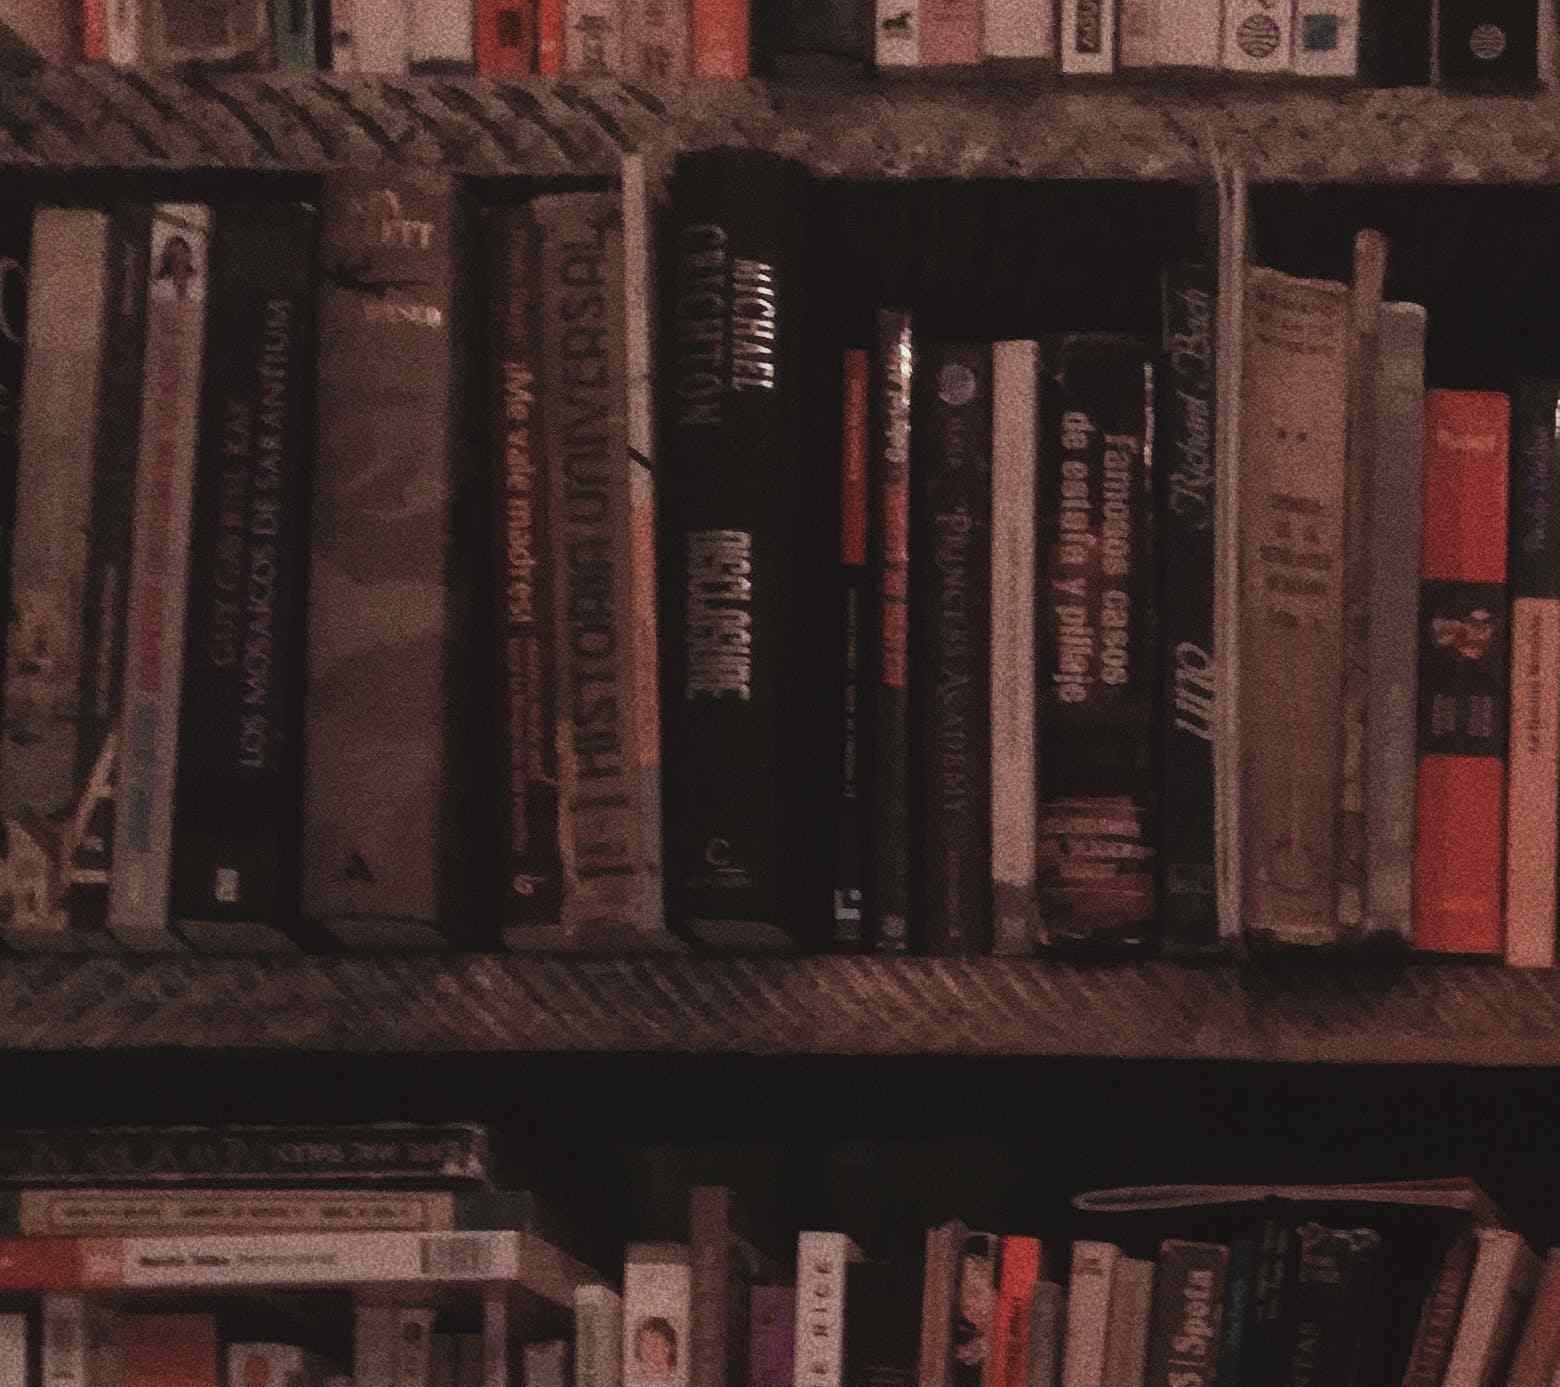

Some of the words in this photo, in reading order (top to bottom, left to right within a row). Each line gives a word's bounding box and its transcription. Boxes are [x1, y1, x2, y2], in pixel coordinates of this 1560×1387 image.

[671, 223, 730, 429] CRICHTON
[730, 261, 775, 391] MICHAEL
[557, 232, 613, 528] UNIVERSAL
[1060, 411, 1095, 449] de
[1058, 460, 1097, 566] estafa
[1100, 434, 1138, 574] Famosos
[1053, 576, 1089, 595] y
[1052, 604, 1095, 704] pillaje
[1100, 590, 1132, 685] casos
[237, 714, 268, 769] LOS
[811, 1258, 833, 1339] RICE
[1172, 1268, 1216, 1356] Spota
